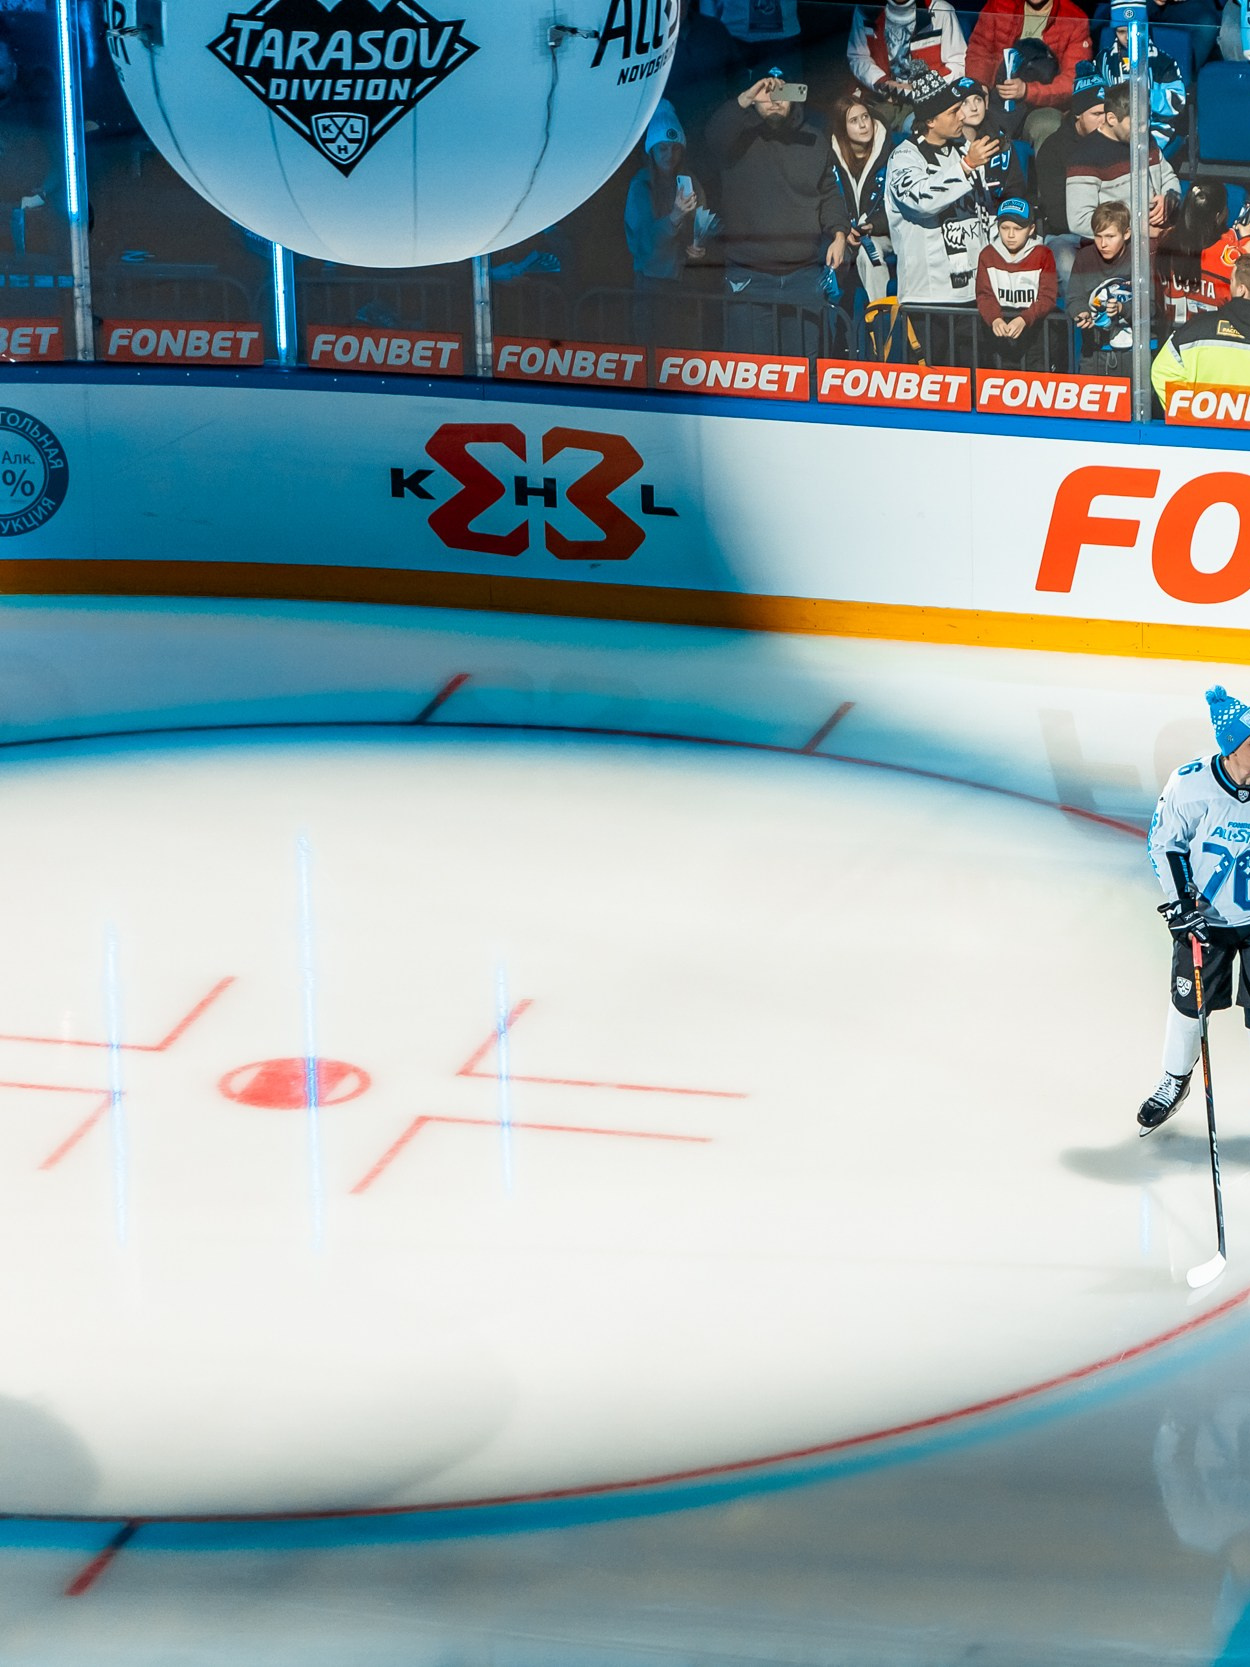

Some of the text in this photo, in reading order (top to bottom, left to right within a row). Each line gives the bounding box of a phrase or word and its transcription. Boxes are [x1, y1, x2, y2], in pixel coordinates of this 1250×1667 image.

[231, 19, 454, 70] TARASOV
[268, 78, 412, 100] DIVISION
[998, 288, 1036, 304] PUMA
[108, 327, 258, 360] FONBET
[311, 334, 459, 368] FONBET
[498, 345, 643, 381] FONBET
[659, 357, 805, 393] FONBET
[820, 367, 967, 403] FONBET
[979, 378, 1127, 413] FONBET
